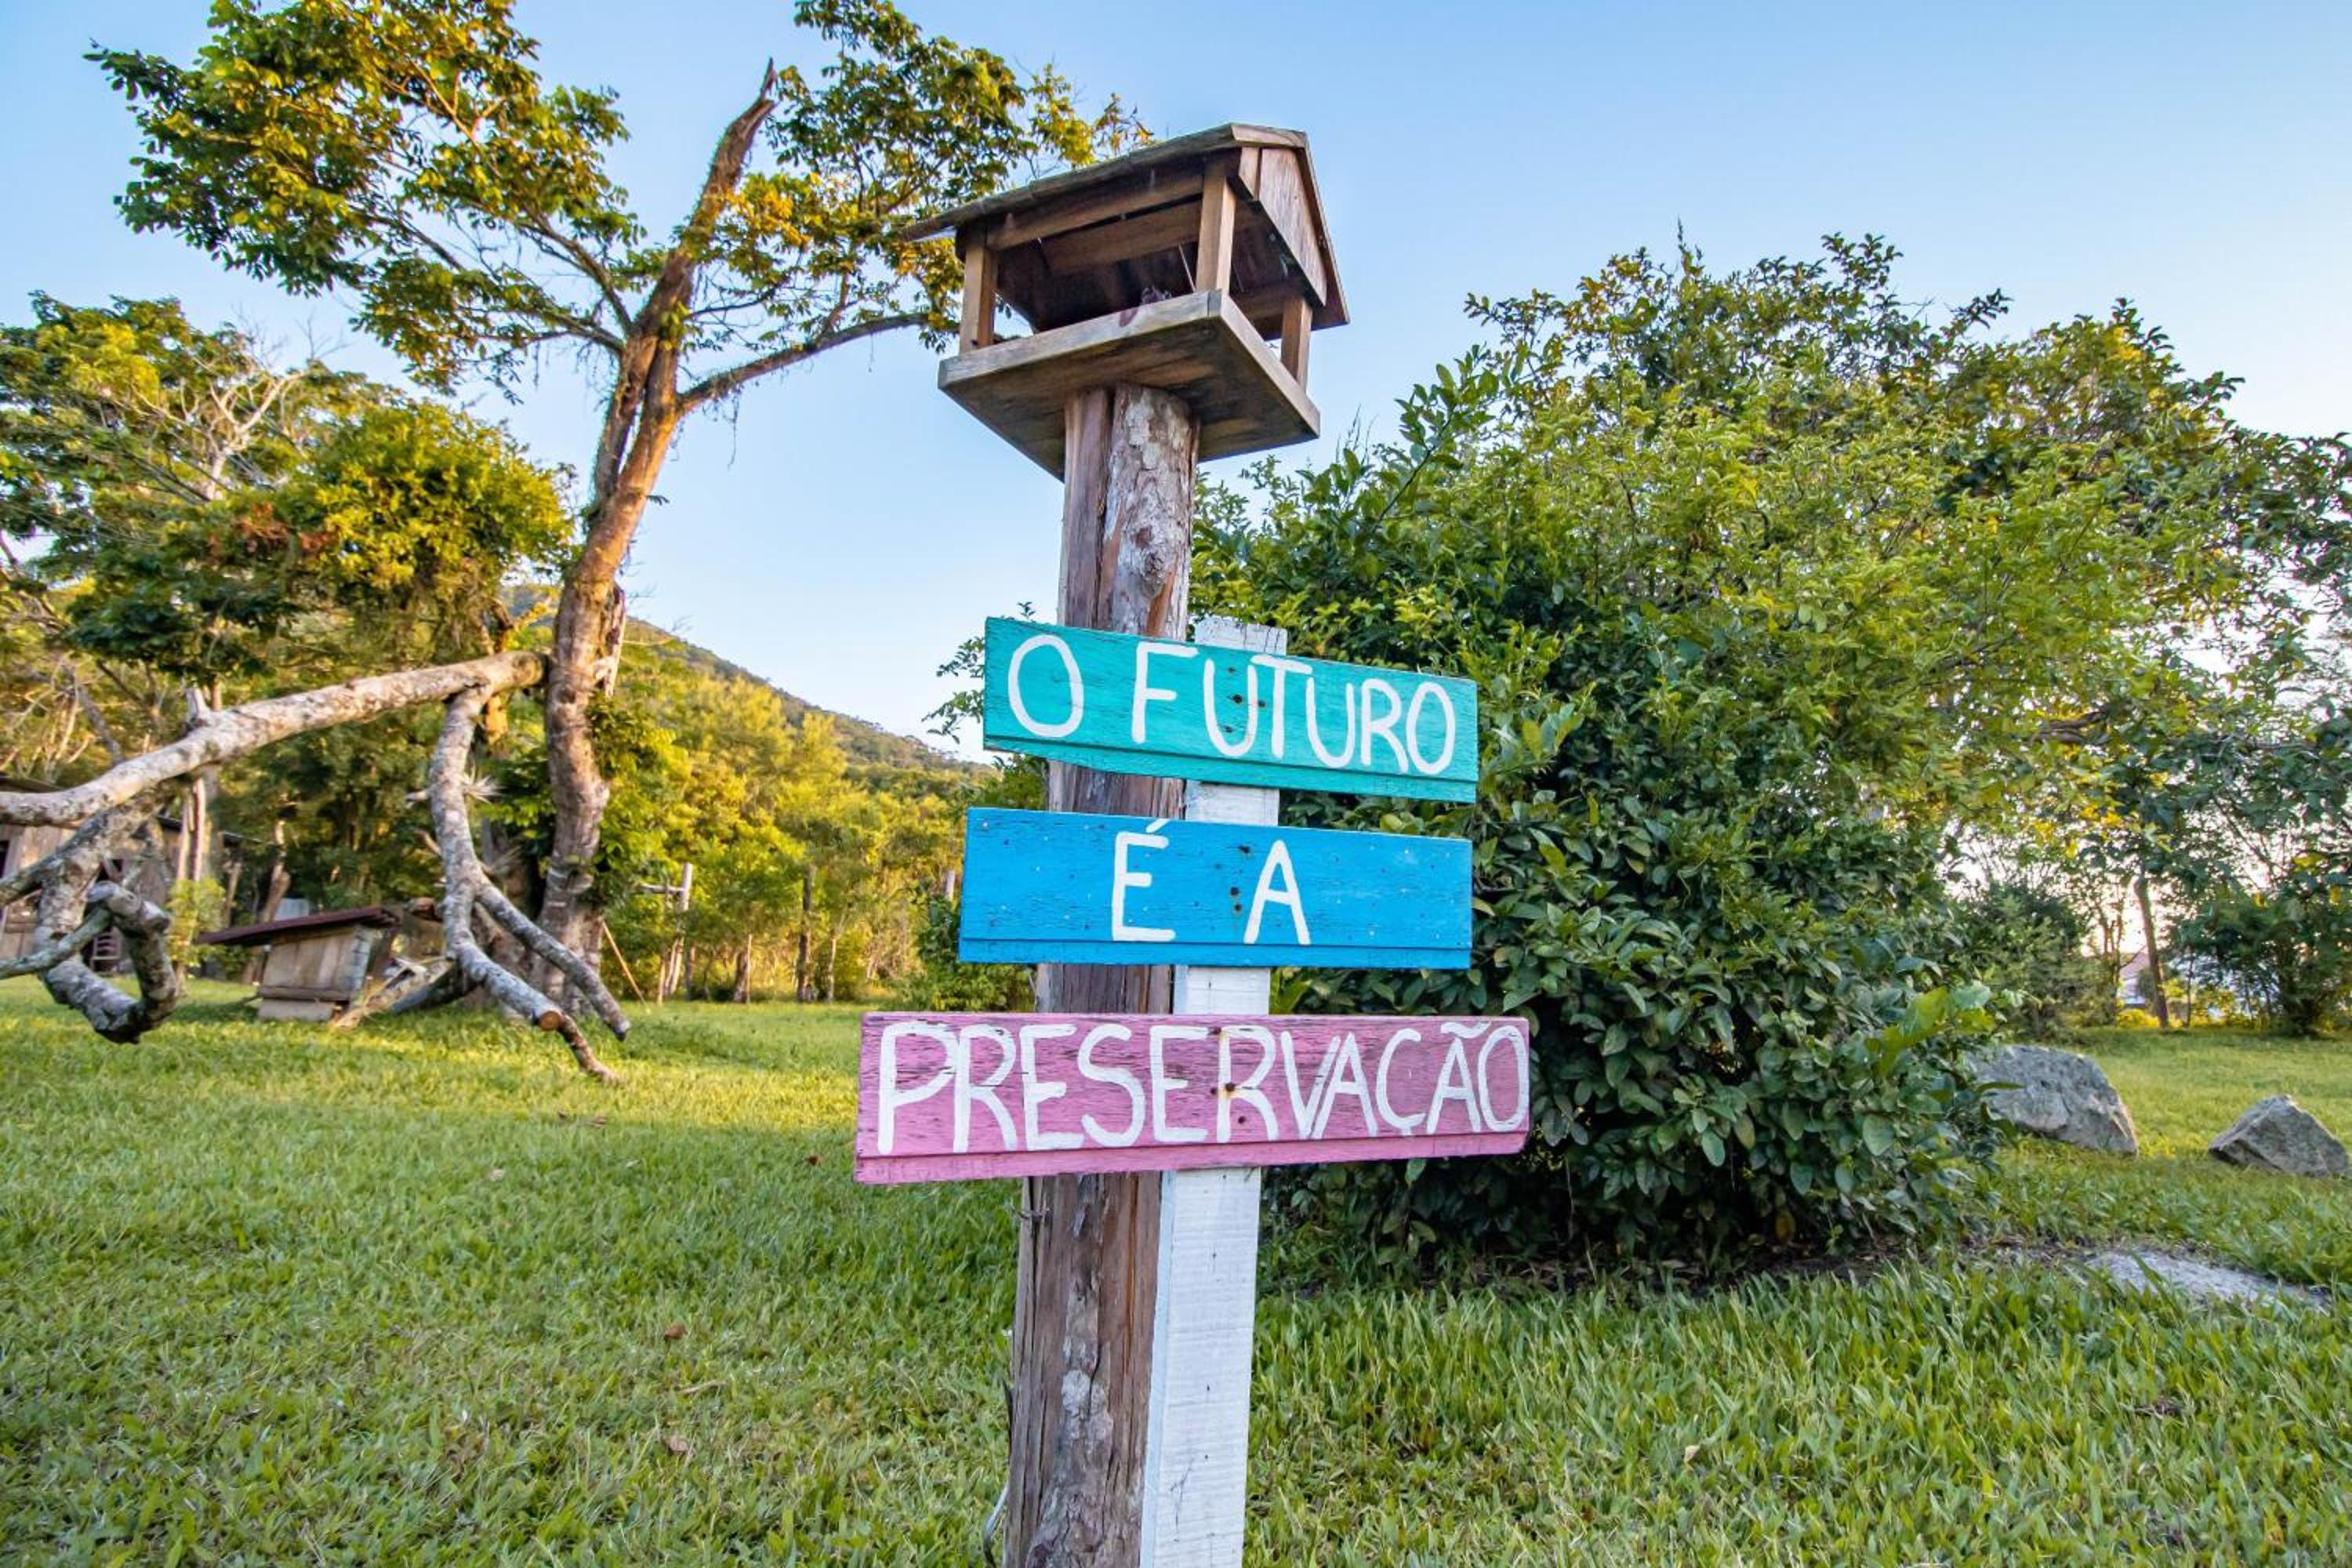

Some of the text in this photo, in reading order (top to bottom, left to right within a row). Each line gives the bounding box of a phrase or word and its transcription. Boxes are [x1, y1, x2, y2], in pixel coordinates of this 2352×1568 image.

[1007, 635, 1456, 775] O FUTURO
[1112, 818, 1311, 945] É A
[877, 1021, 1530, 1155] PRESERVAÇÃO
